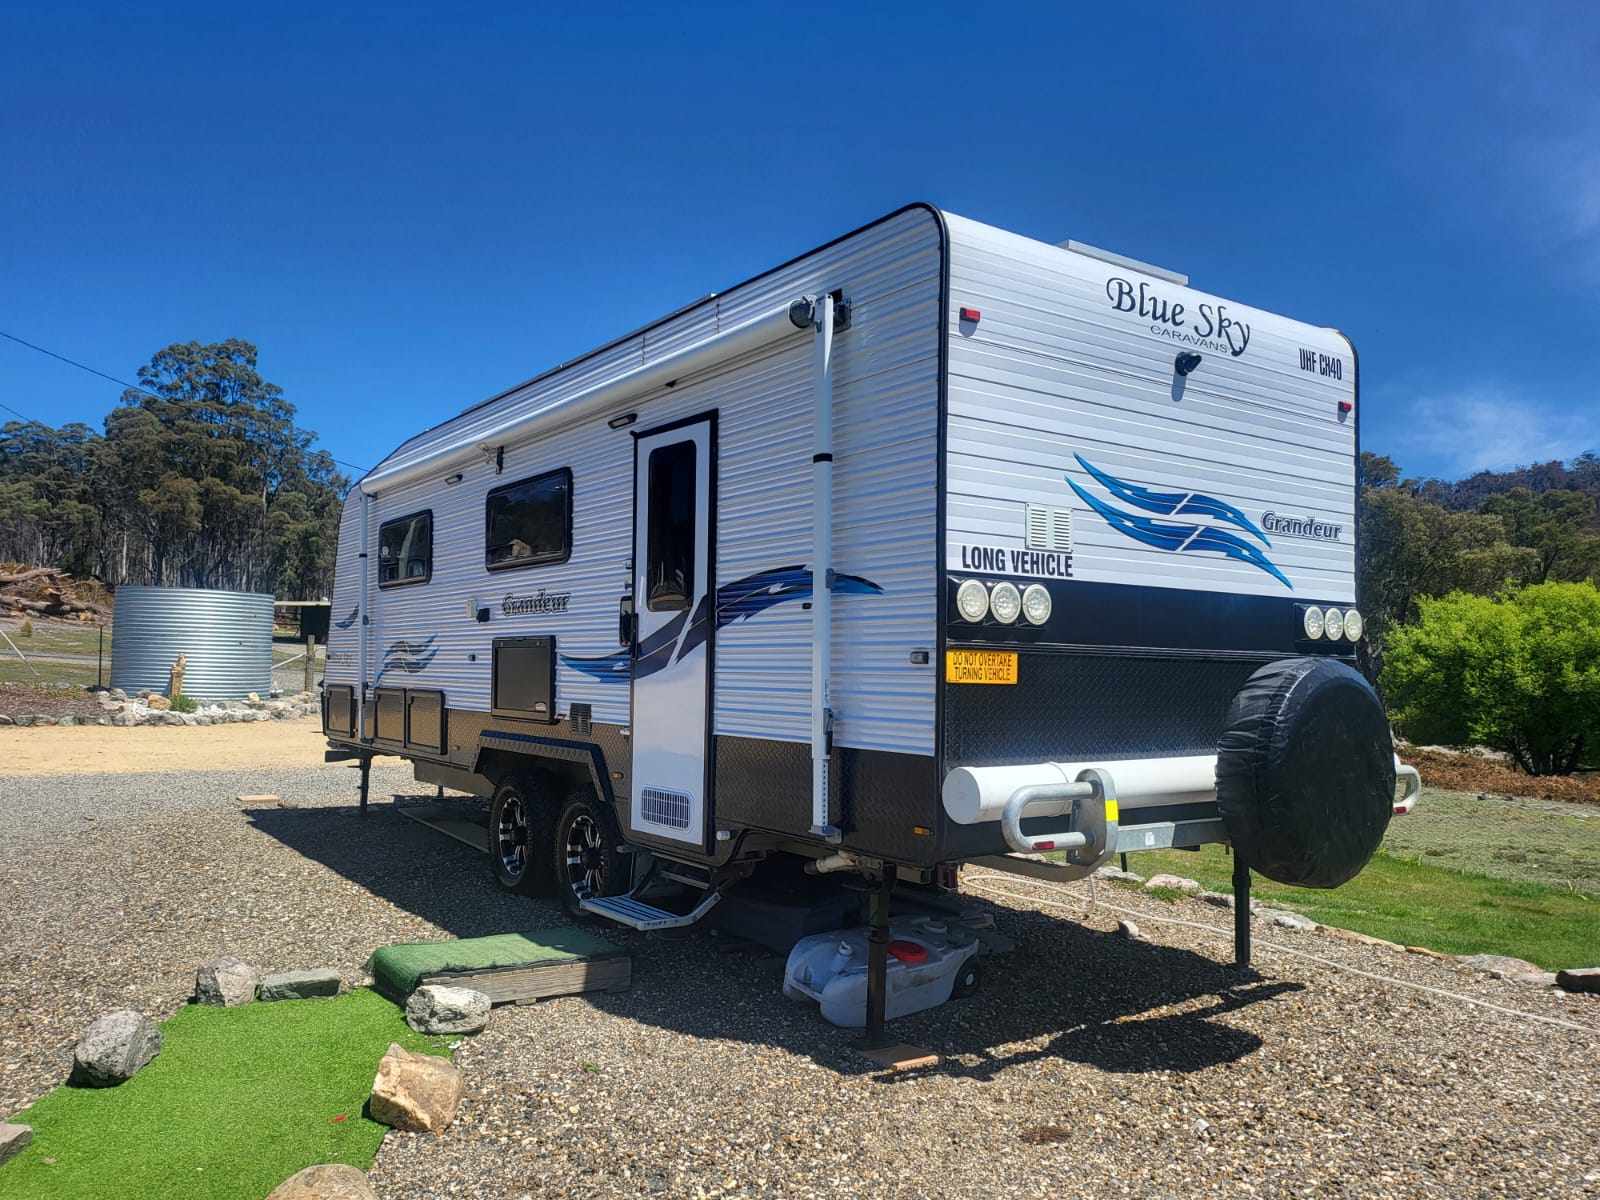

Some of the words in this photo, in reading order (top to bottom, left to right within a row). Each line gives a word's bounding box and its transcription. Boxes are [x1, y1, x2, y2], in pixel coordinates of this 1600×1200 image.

[1106, 277, 1185, 327] Blue
[1194, 303, 1251, 357] Sky
[1150, 325, 1228, 354] CARAVANS
[1298, 347, 1317, 373] UHF
[1319, 353, 1342, 381] CH40
[1261, 510, 1342, 541] Grandeur
[961, 545, 1006, 572] LONG
[1010, 549, 1074, 578] VEHICLE
[502, 587, 571, 616] Grandeur
[953, 651, 963, 666] DO
[964, 652, 978, 666] NOT
[978, 653, 1012, 668] OVERTAKE
[954, 666, 983, 681] TURNING
[984, 668, 1011, 681] VEHICLE
